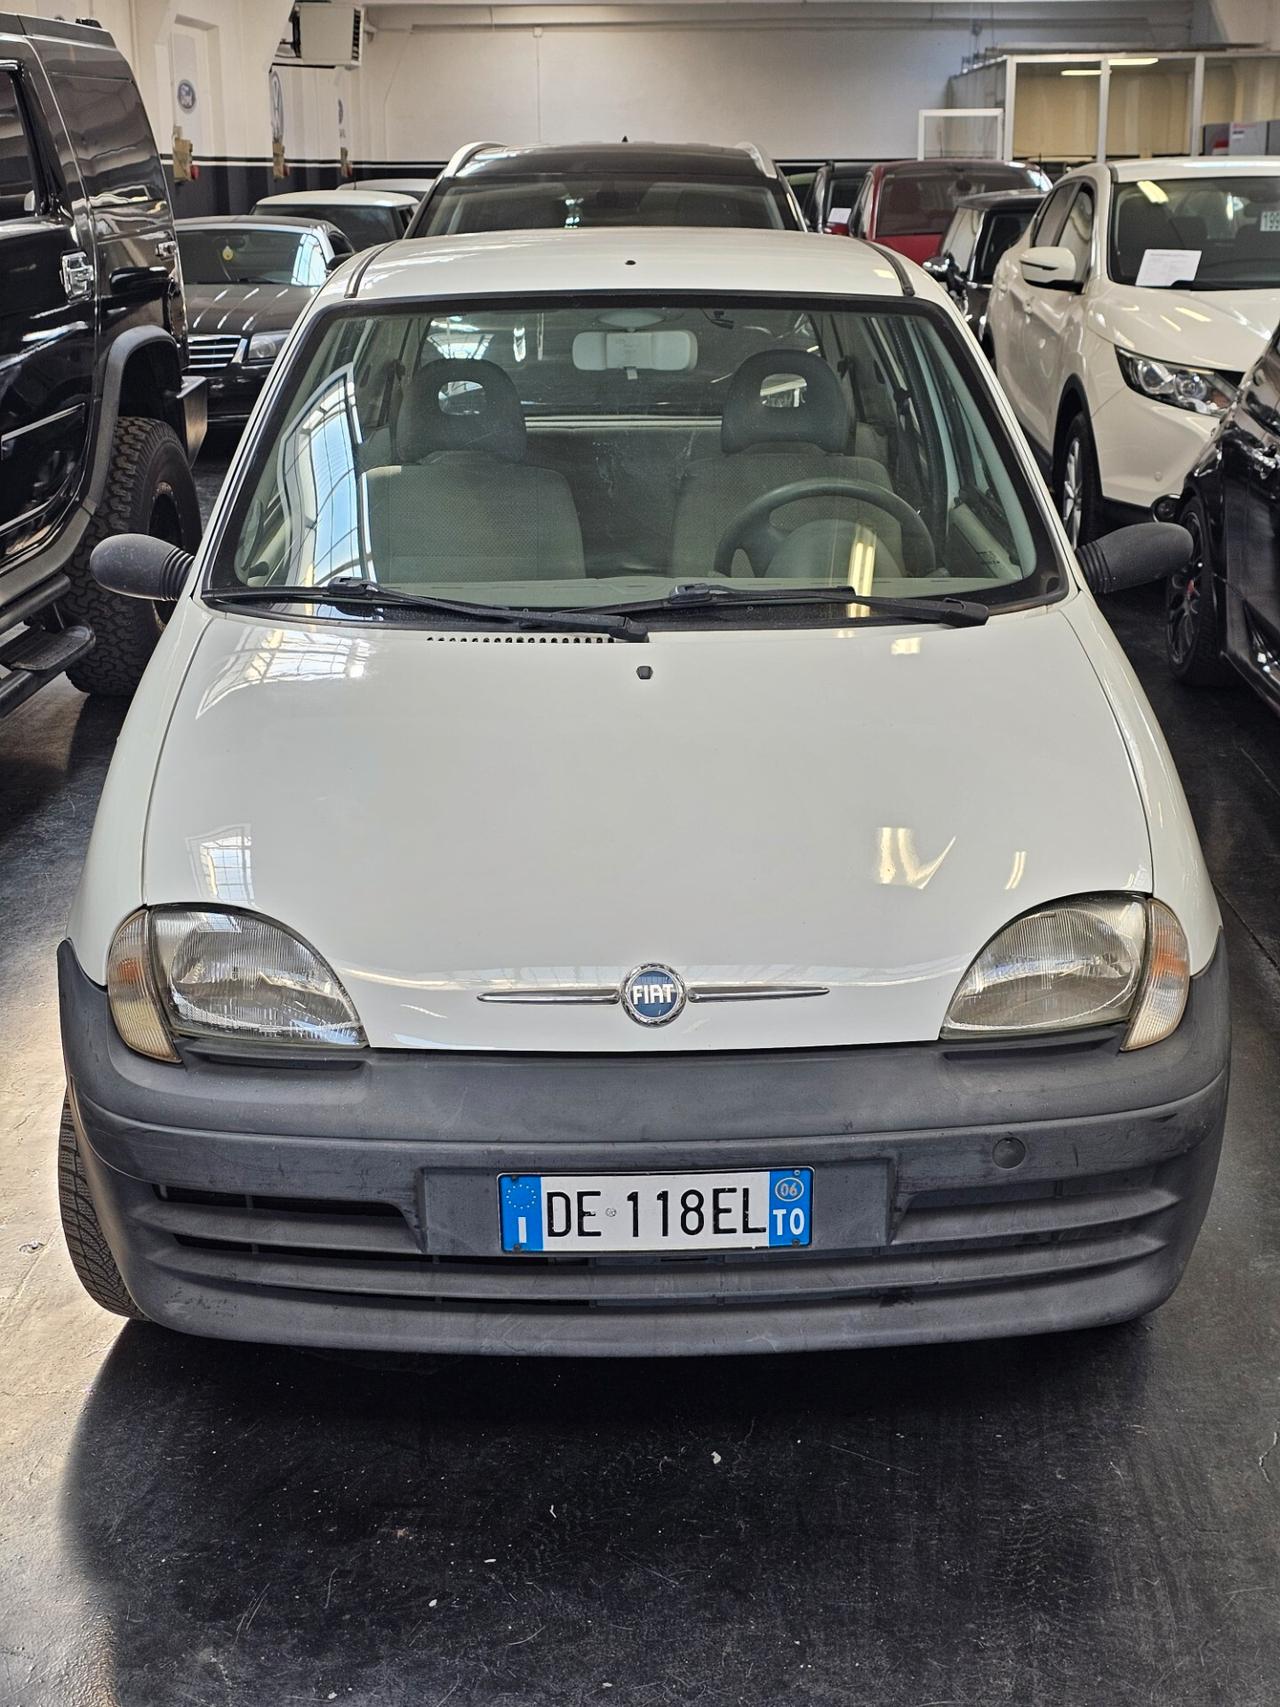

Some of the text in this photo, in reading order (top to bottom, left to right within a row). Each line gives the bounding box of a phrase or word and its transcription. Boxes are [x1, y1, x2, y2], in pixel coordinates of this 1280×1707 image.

[632, 983, 674, 1005] FIAT
[780, 1182, 798, 1197] 06
[546, 1187, 767, 1238] DE 118EL
